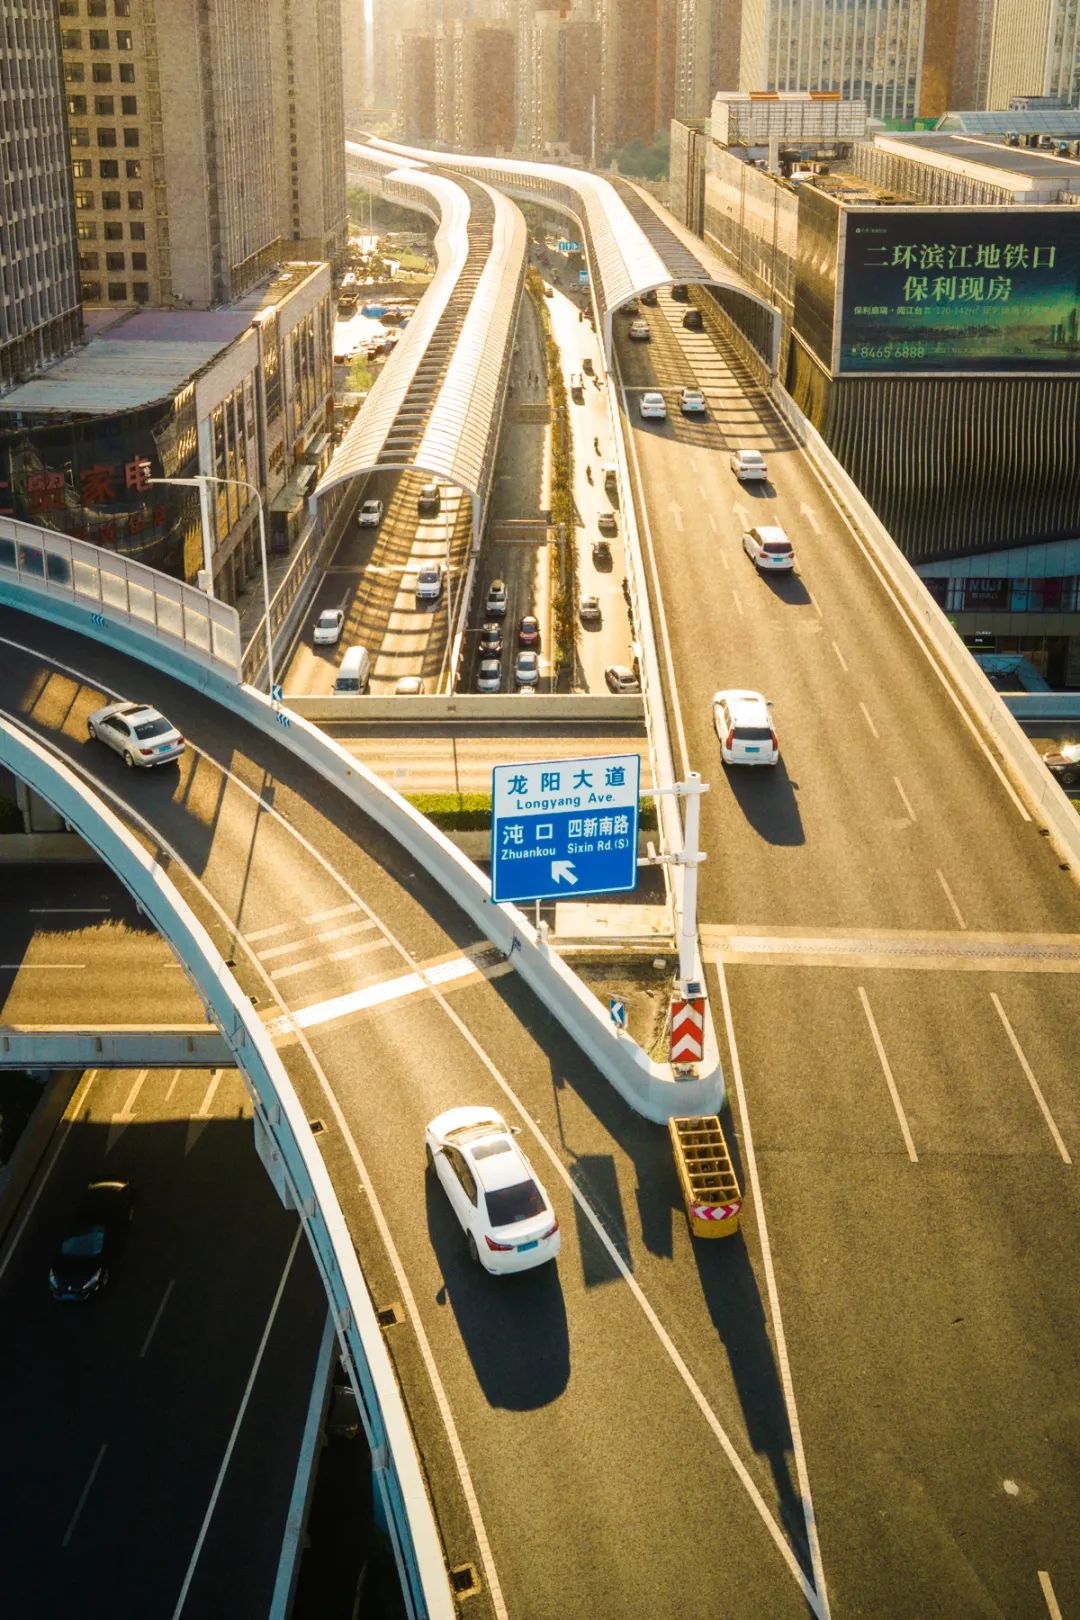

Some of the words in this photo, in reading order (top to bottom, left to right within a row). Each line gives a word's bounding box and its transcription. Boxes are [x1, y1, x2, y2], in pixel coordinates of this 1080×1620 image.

[864, 243, 1056, 269] 二环滨江地铁口
[903, 275, 1012, 301] 保利现房
[861, 346, 890, 358] 8465
[895, 346, 925, 358] 6888
[507, 766, 625, 795] 龙阳大道
[516, 796, 581, 810] Longyang
[588, 793, 615, 804] Ave.
[502, 824, 553, 845] 沌口
[568, 815, 629, 838] 四新南路
[501, 846, 556, 860] Zhuankou
[567, 842, 594, 854] Sixin
